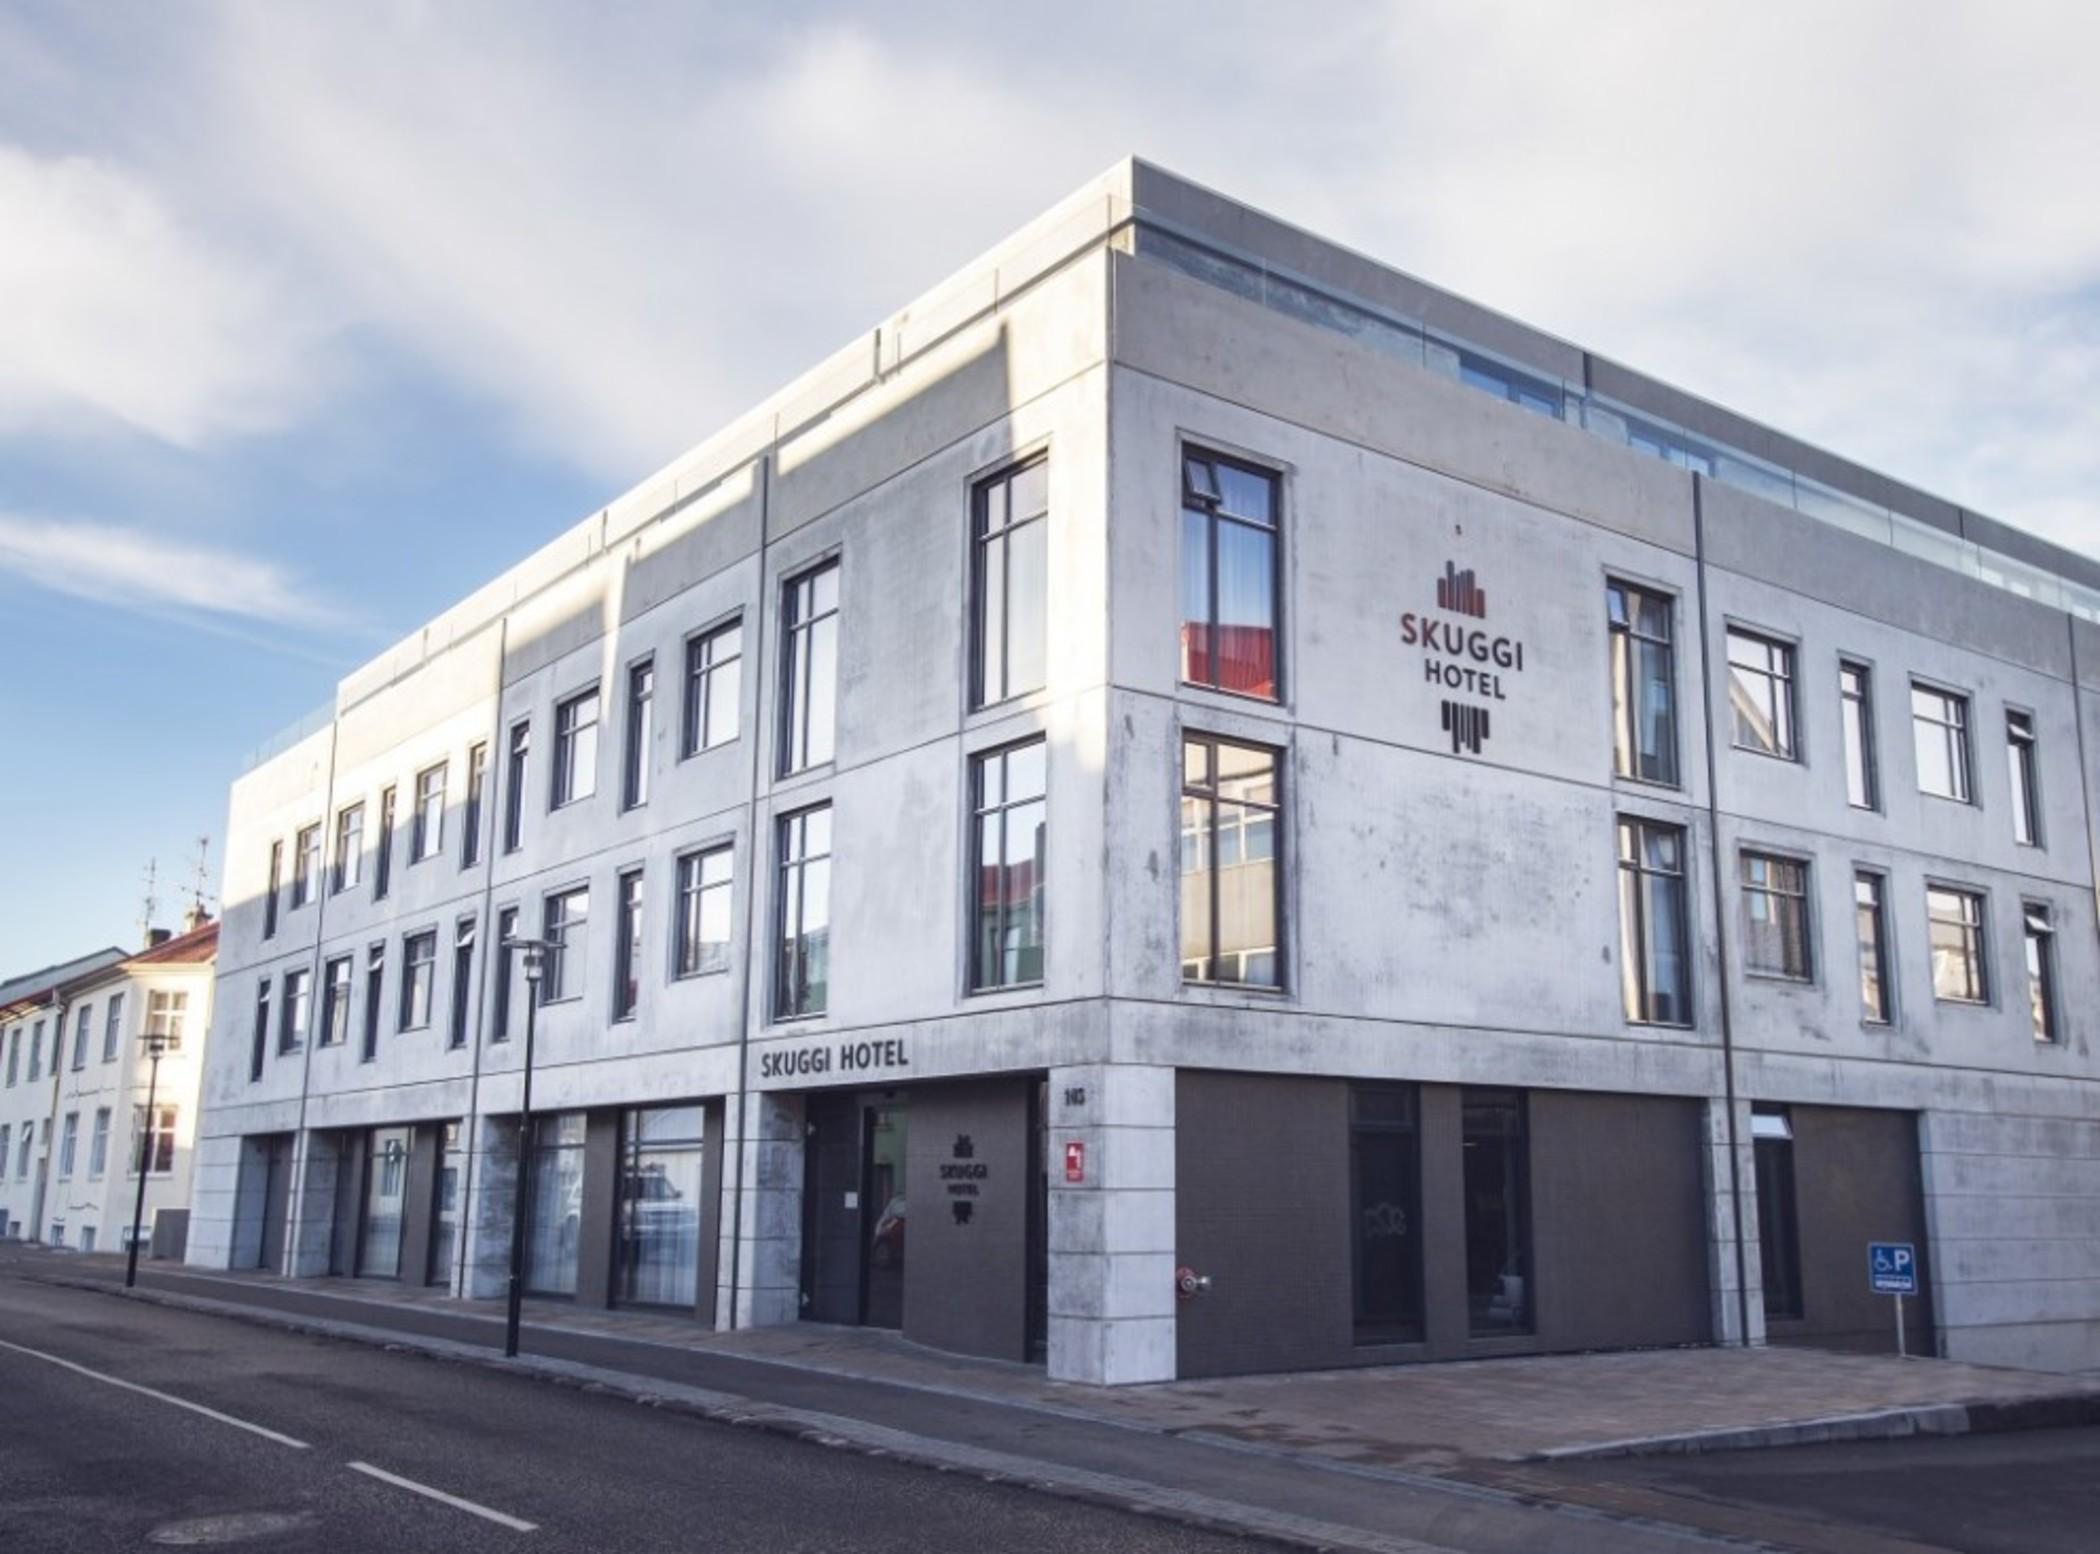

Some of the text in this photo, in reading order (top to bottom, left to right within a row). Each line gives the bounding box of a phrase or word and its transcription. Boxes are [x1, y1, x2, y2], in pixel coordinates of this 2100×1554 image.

[1401, 613, 1523, 671] SKUGGI
[1424, 659, 1506, 700] HOTEL
[761, 1040, 909, 1078] SKUGGI HOTEL
[940, 1164, 987, 1179] SKUGGI
[947, 1184, 980, 1196] HOTEL
[1894, 1249, 1910, 1271] P
